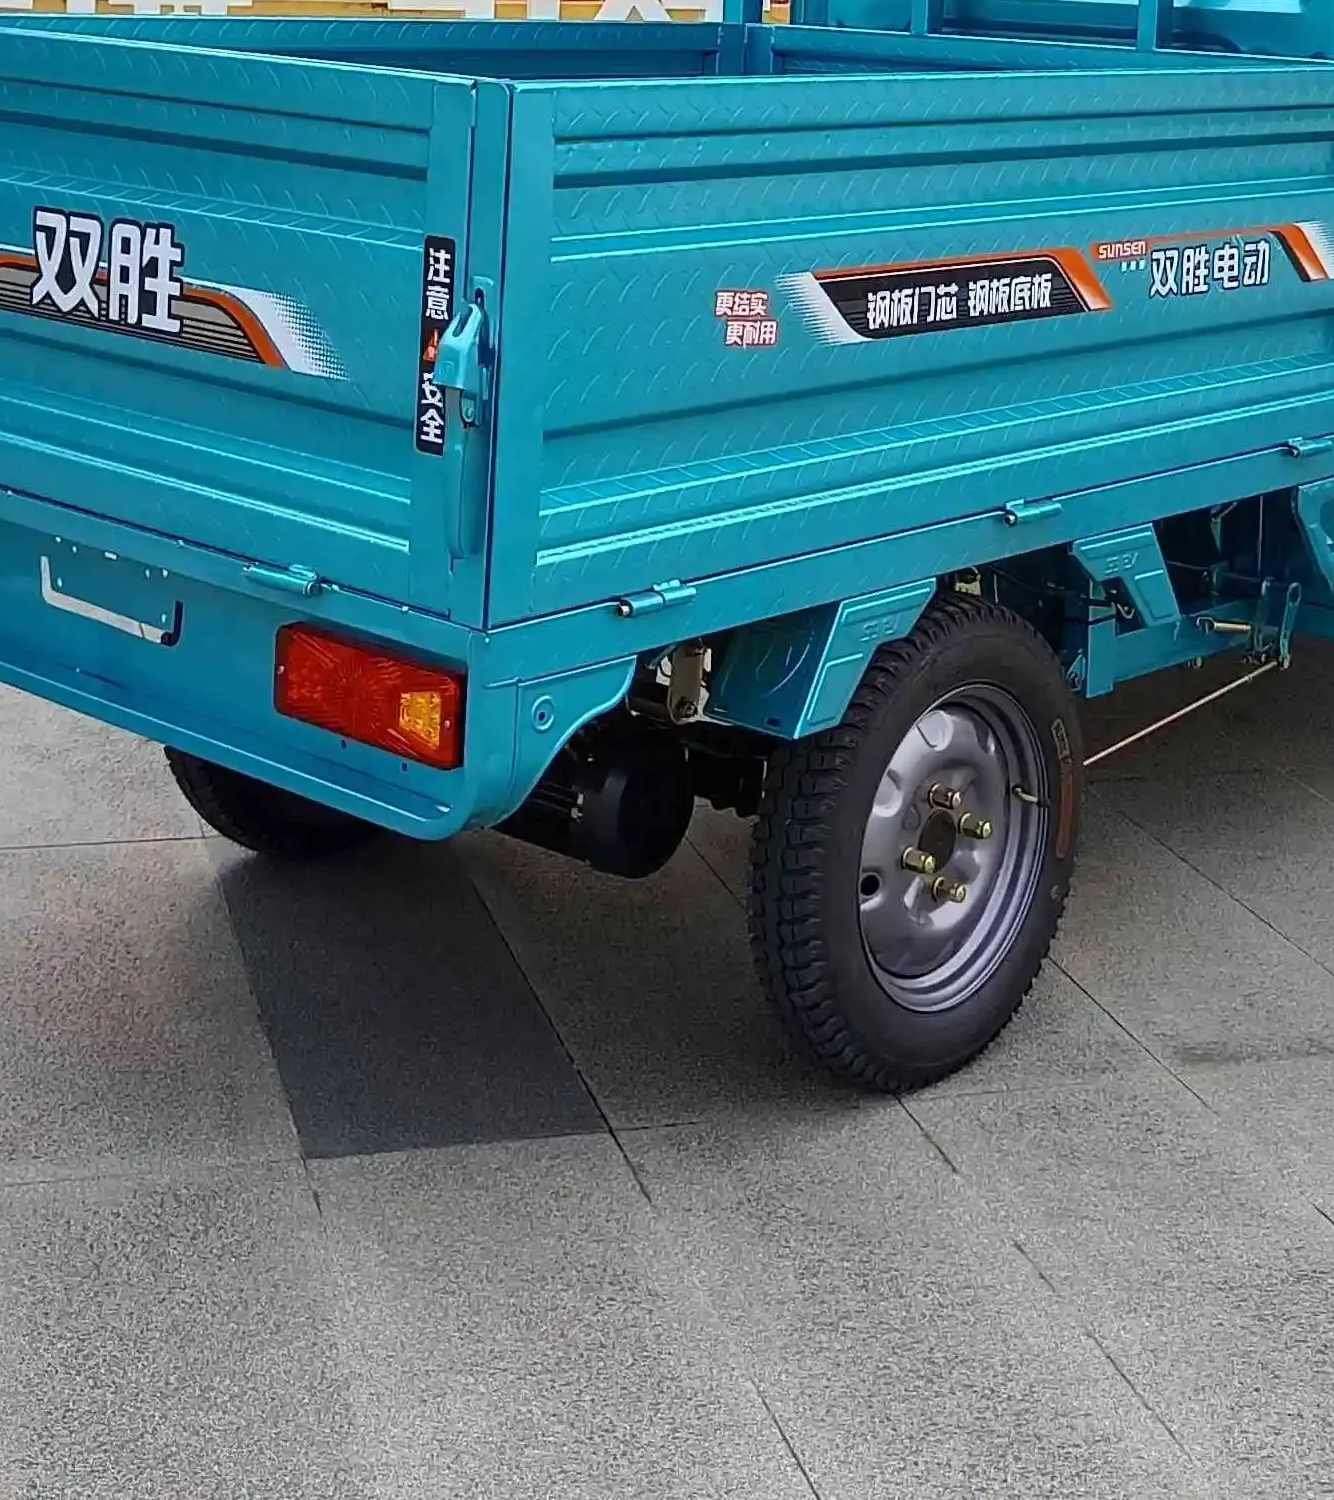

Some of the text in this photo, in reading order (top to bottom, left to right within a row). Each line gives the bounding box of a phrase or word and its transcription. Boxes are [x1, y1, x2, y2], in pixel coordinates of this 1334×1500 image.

[31, 209, 183, 333] 双胜
[425, 248, 451, 320] 注意
[1149, 239, 1271, 297] 双胜电动
[715, 291, 768, 316] 更结实
[866, 272, 1052, 330] 钢板门芯 钢板底板
[725, 320, 777, 345] 更耐用
